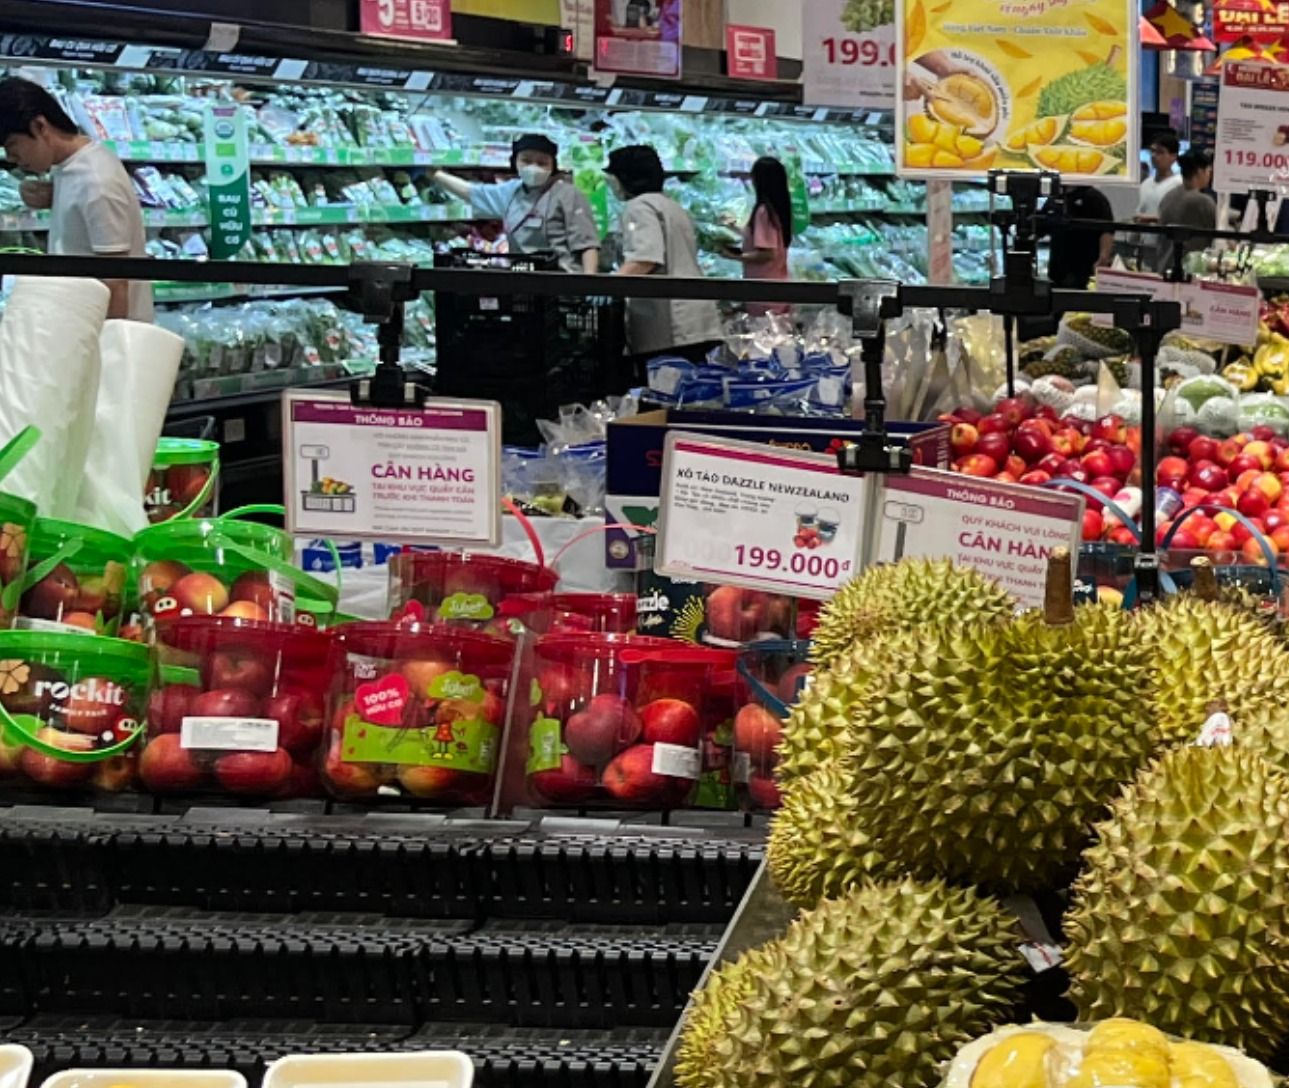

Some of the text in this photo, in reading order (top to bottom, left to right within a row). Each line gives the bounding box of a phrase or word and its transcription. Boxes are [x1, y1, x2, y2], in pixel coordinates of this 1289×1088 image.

[371, 461, 475, 482] CÂN HÀNG
[722, 474, 765, 491] DAZZLE
[769, 482, 850, 504] NEWZEALAND
[958, 528, 1052, 560] CÂN HÀN
[735, 544, 851, 579] 199.000đ
[35, 677, 125, 706] rockit
